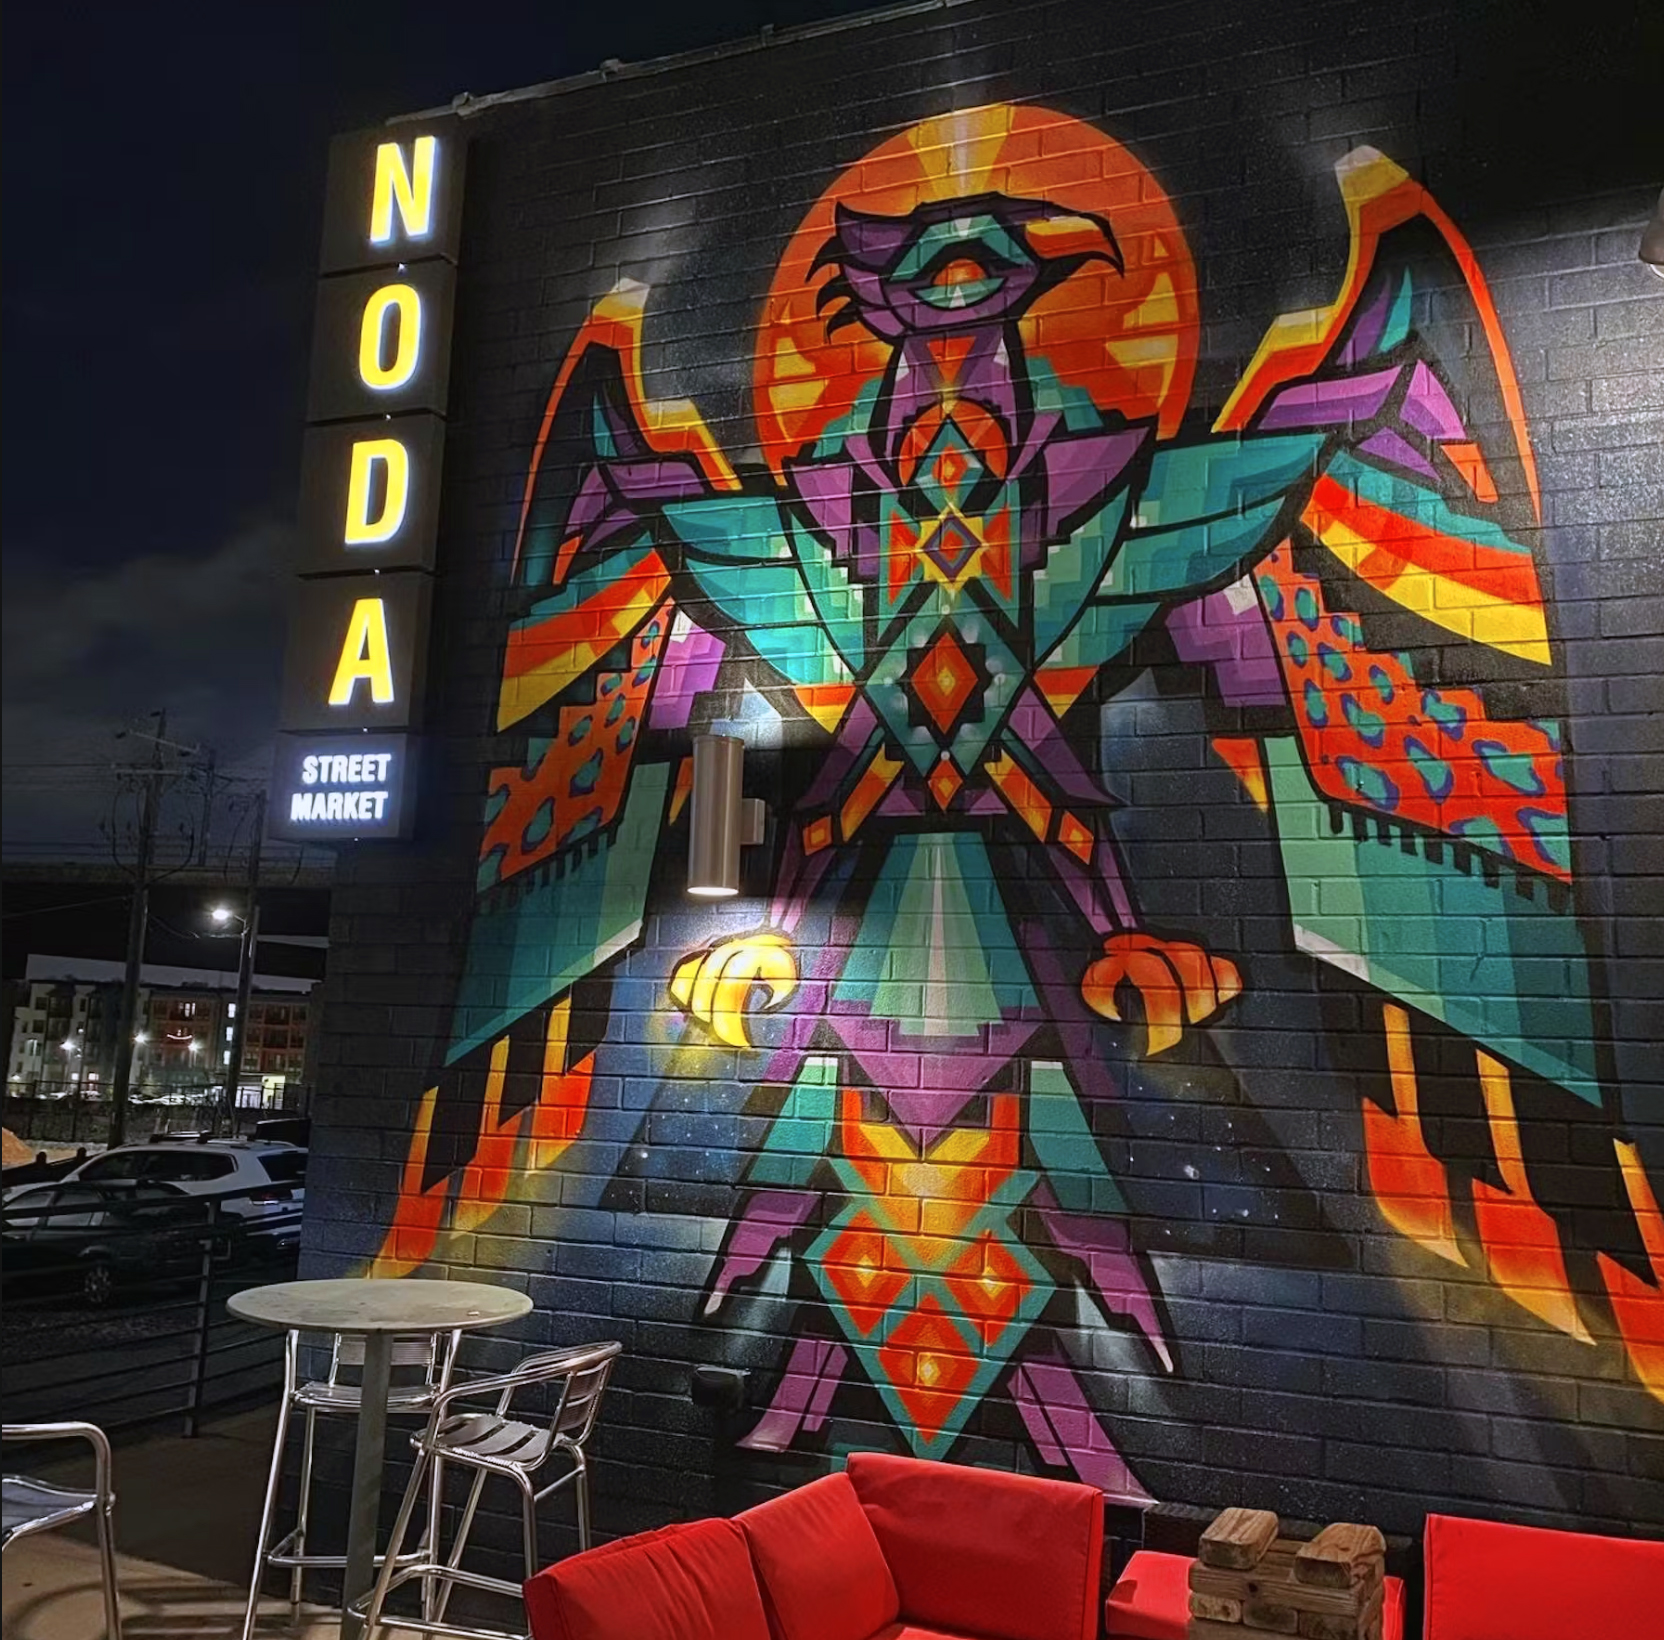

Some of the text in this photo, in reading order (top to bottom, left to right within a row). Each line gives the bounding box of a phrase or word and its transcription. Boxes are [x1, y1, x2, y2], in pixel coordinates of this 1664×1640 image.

[328, 135, 436, 706] NODA
[302, 753, 392, 785] STREET
[290, 791, 389, 821] MARKET
